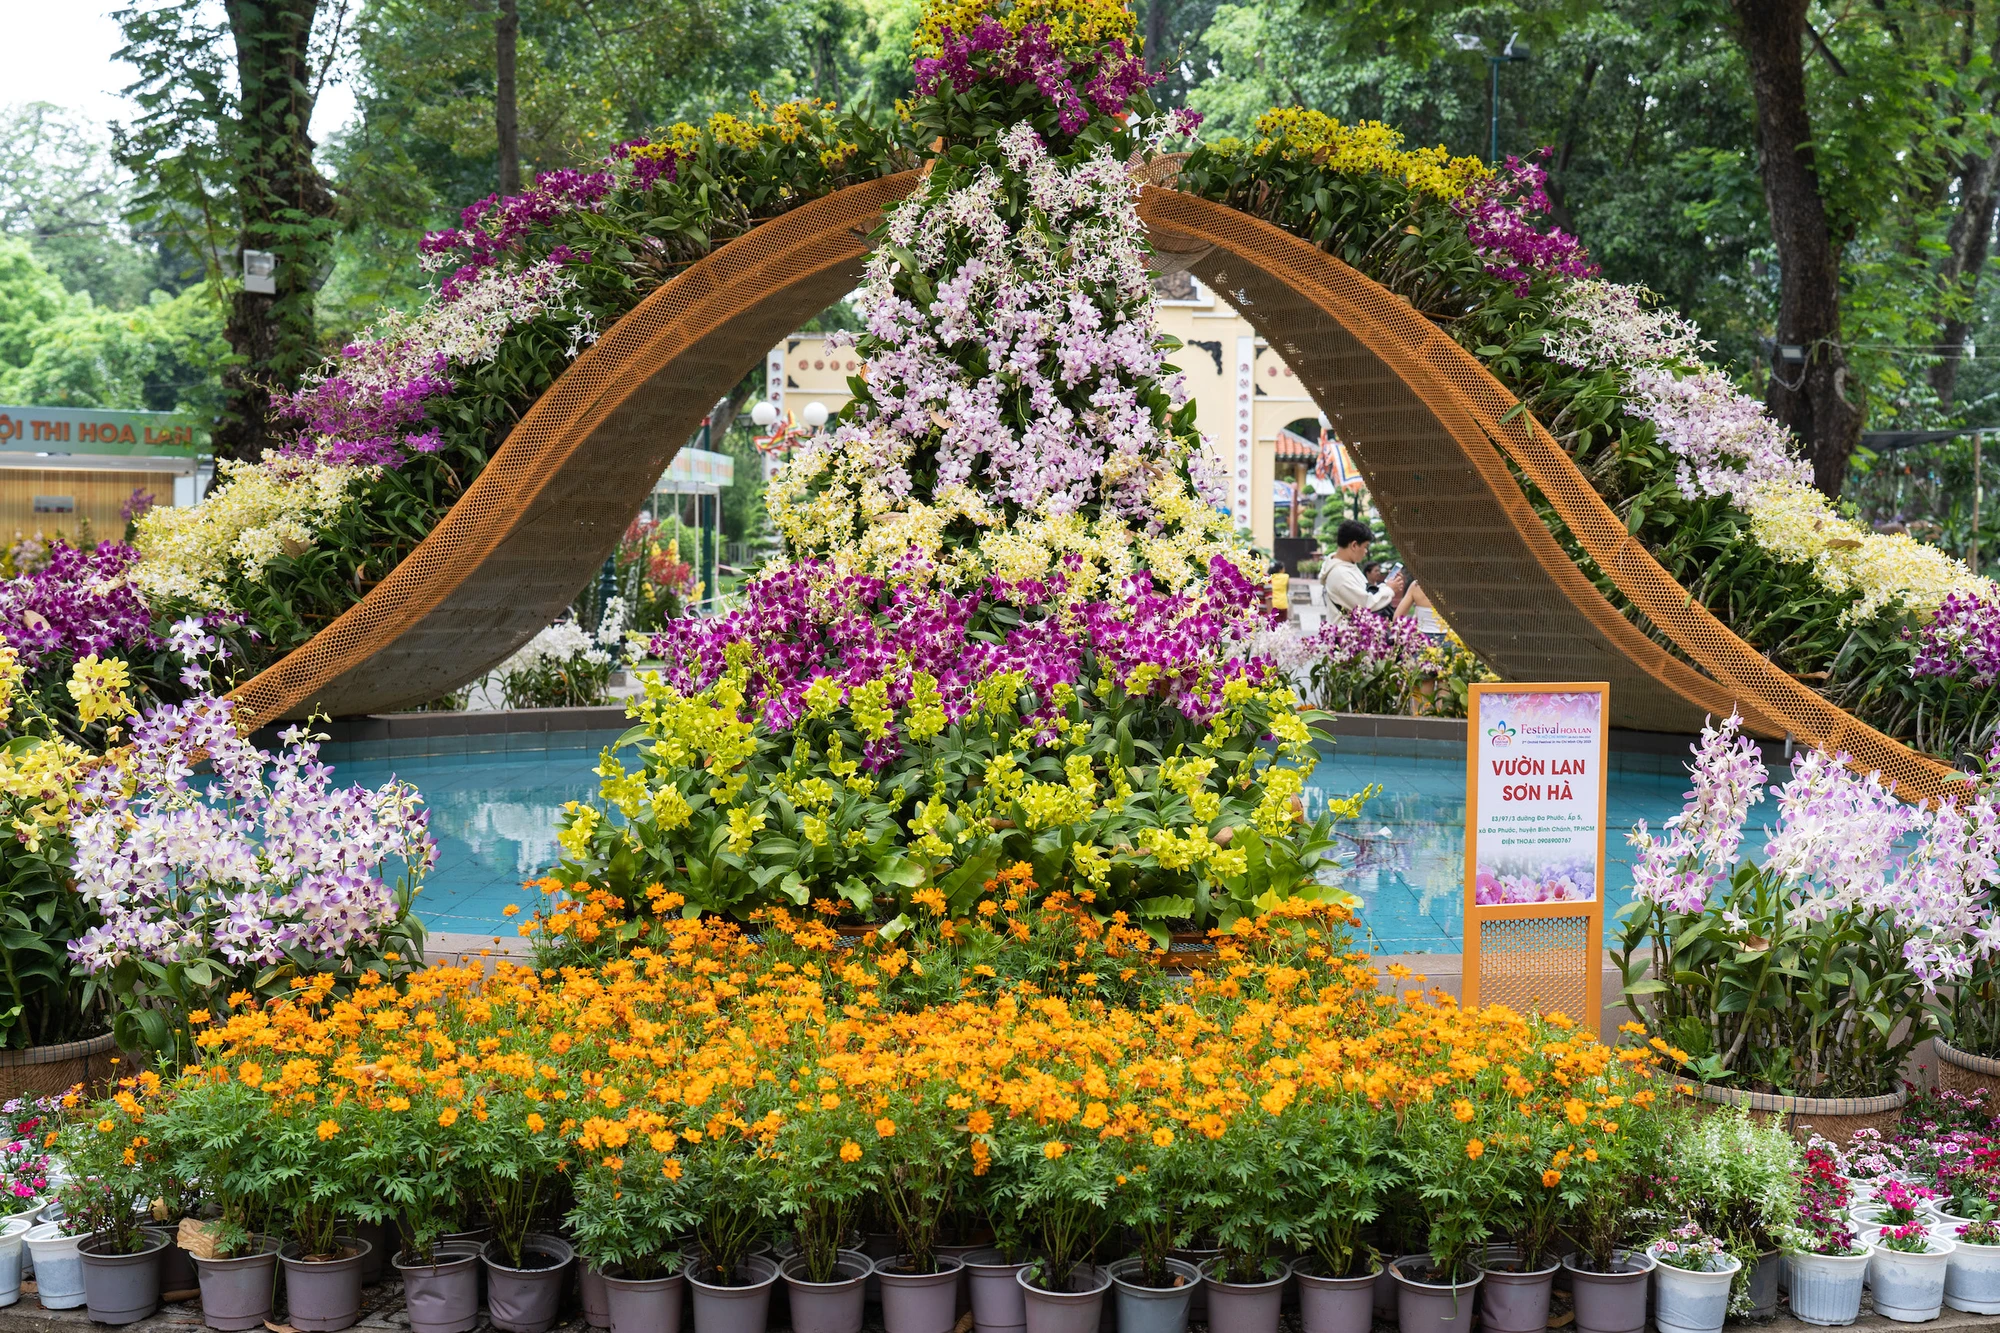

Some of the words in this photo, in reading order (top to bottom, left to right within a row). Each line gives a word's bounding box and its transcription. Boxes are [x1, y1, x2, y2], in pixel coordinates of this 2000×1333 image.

[30, 420, 70, 441] THI
[78, 422, 136, 444] HOA
[144, 426, 192, 446] LAN
[1521, 722, 1559, 734] Festival
[1492, 755, 1545, 776] VƯỜN
[1551, 759, 1585, 776] LAN
[1502, 783, 1541, 802] SƠN
[1547, 780, 1573, 801] HÀ
[1501, 838, 1515, 846] ĐIỆN
